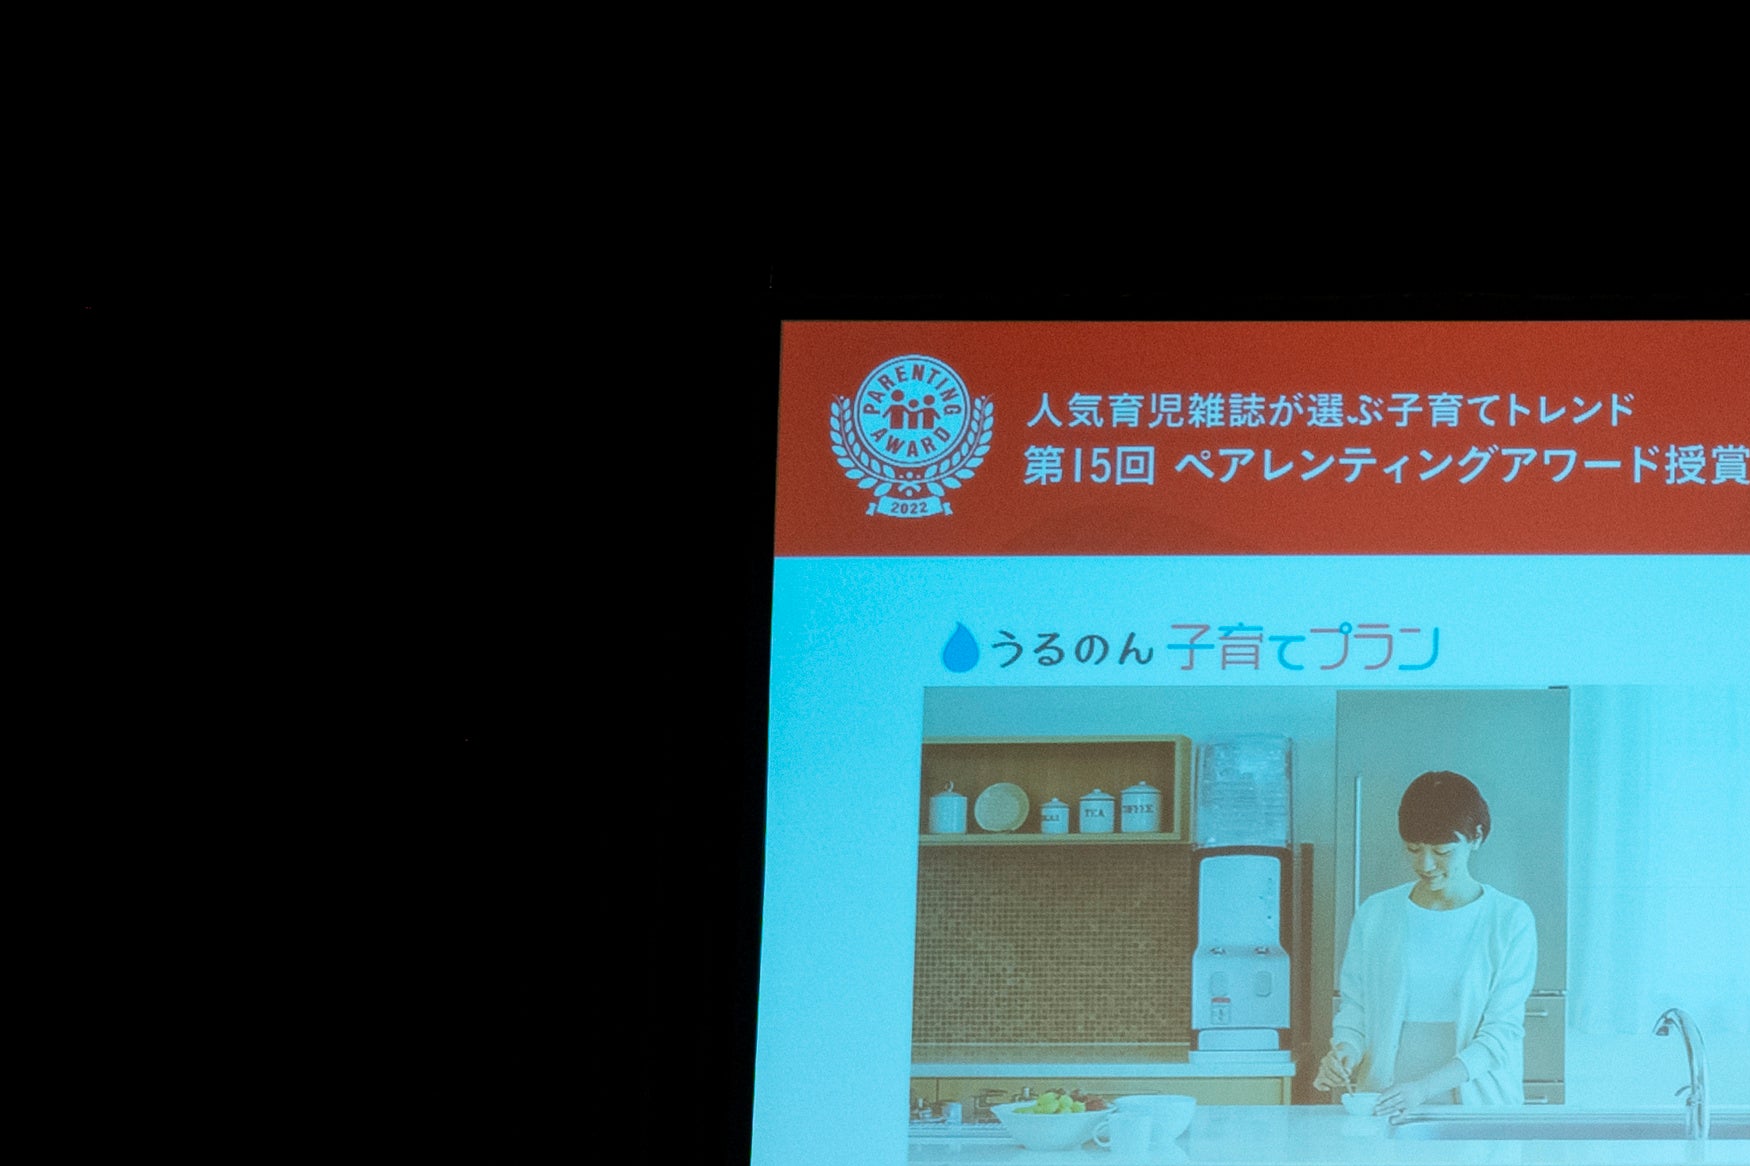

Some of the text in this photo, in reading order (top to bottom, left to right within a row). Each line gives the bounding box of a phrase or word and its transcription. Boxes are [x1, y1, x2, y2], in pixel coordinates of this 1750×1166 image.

[863, 364, 961, 415] PARENTING
[1026, 392, 1634, 429] 人気育児雑誌が選ぶ子育てトレンド
[871, 427, 951, 457] AWARD
[1024, 444, 1156, 486] 第15回
[891, 502, 928, 514] 2022
